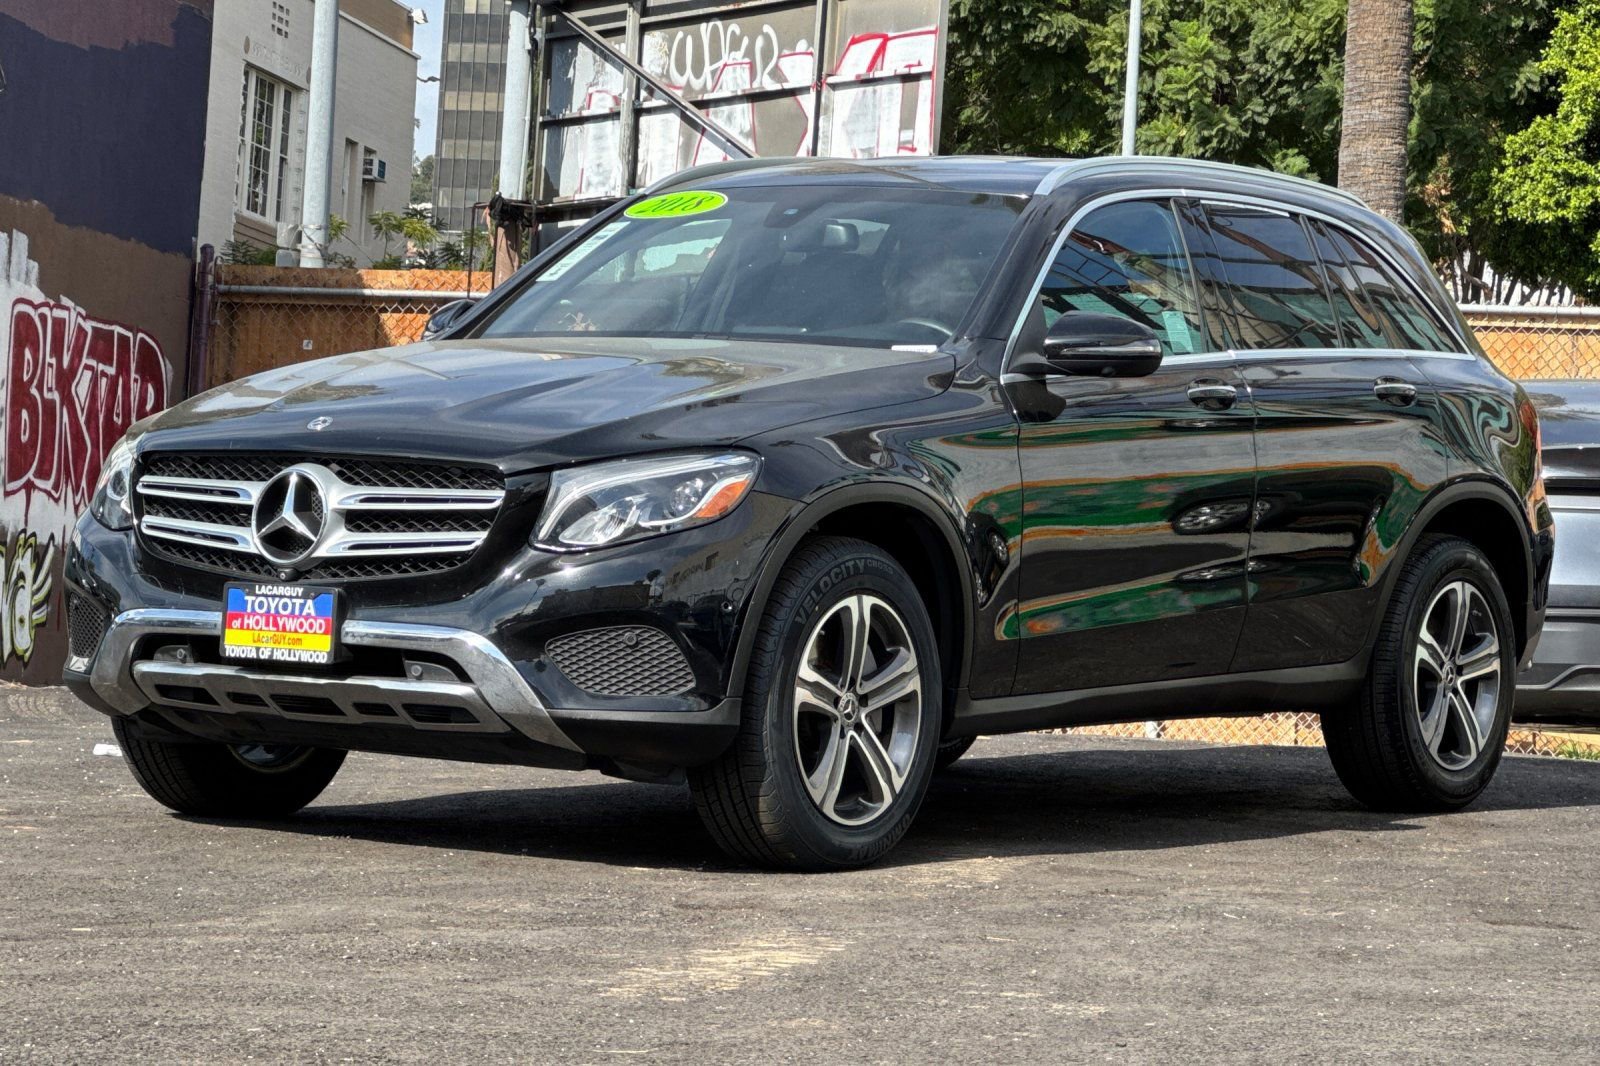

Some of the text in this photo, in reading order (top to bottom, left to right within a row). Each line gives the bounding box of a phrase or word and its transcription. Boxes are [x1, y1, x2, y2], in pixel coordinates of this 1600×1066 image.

[634, 196, 716, 214] 2018
[255, 585, 304, 596] LACARGUY
[794, 559, 865, 624] VELOCITY
[244, 596, 316, 616] TOYOTA
[231, 615, 326, 634] of HOLLYWOOD
[252, 633, 303, 646] LAcarGUY.com
[225, 645, 328, 664] TOYOTA OF HOLLYWOOD
